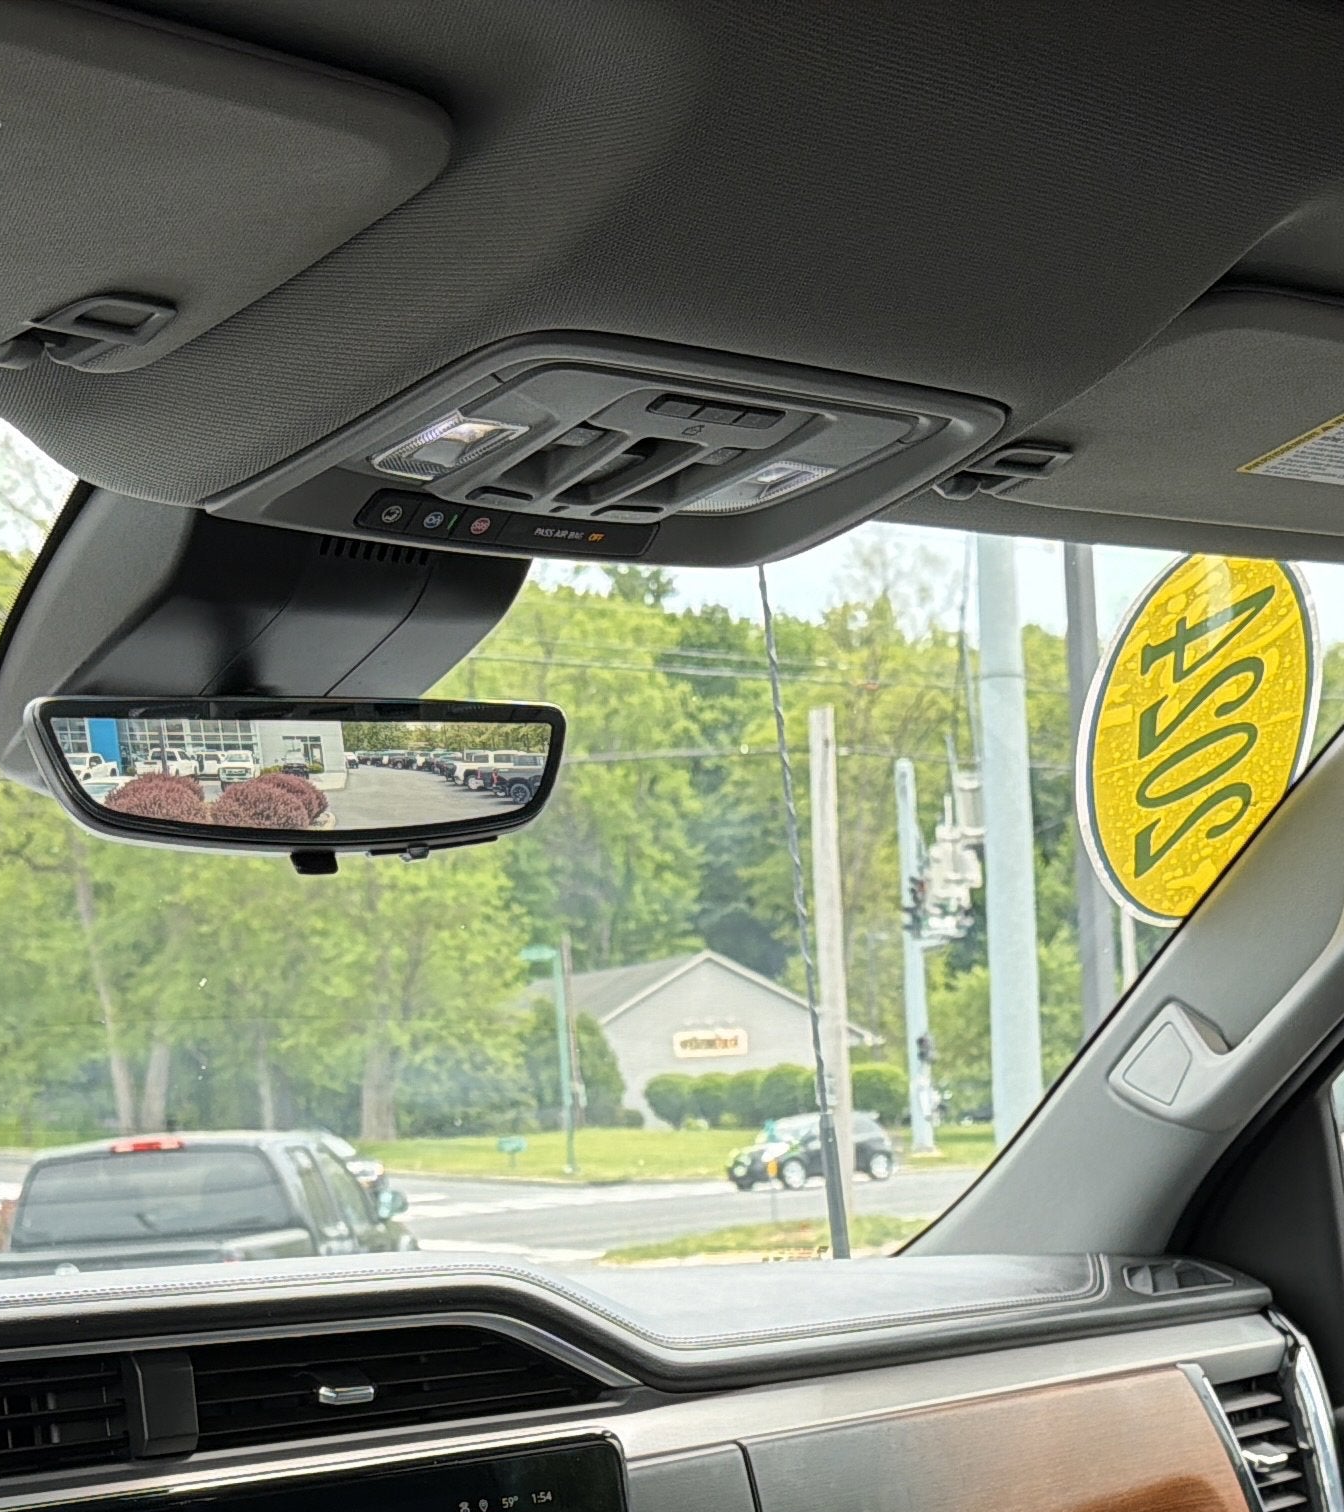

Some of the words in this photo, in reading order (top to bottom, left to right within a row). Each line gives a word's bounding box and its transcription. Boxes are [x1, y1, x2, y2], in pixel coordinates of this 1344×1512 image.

[534, 527, 556, 537] PASS
[588, 533, 605, 542] OFF
[531, 1490, 553, 1504] 1:54
